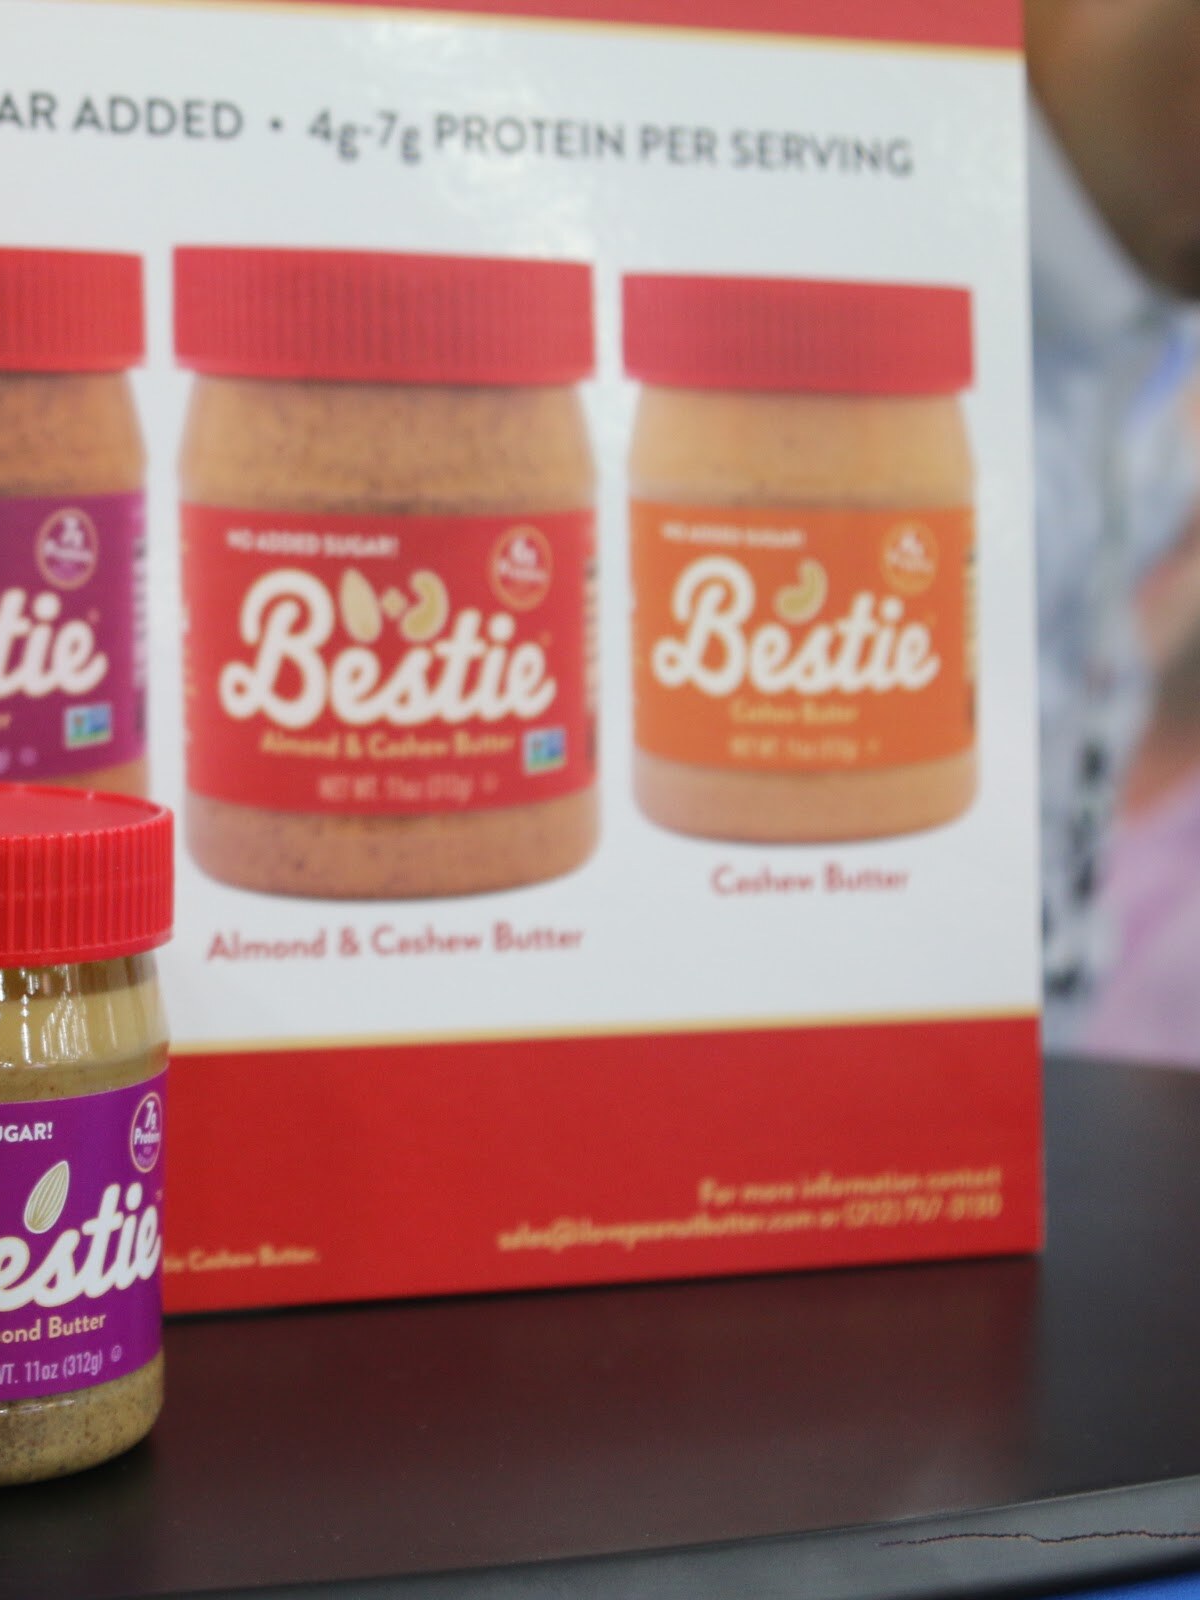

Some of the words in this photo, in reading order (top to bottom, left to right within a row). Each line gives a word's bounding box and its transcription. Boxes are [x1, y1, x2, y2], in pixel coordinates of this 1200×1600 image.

[72, 95, 245, 140] ADDED
[434, 111, 627, 159] PROTEIN
[638, 120, 718, 166] PER
[729, 128, 915, 178] SERVING
[651, 555, 941, 696] Bestie
[218, 567, 557, 729] Bestie
[711, 866, 814, 896] Cashew
[822, 864, 910, 893] Butter
[206, 927, 326, 962] Almond
[339, 927, 360, 957] &
[372, 924, 483, 955] Cashew
[492, 921, 584, 953] Butter
[48, 1314, 106, 1339] Butter
[24, 1360, 58, 1383] 11oz
[62, 1350, 103, 1379] (312g)
